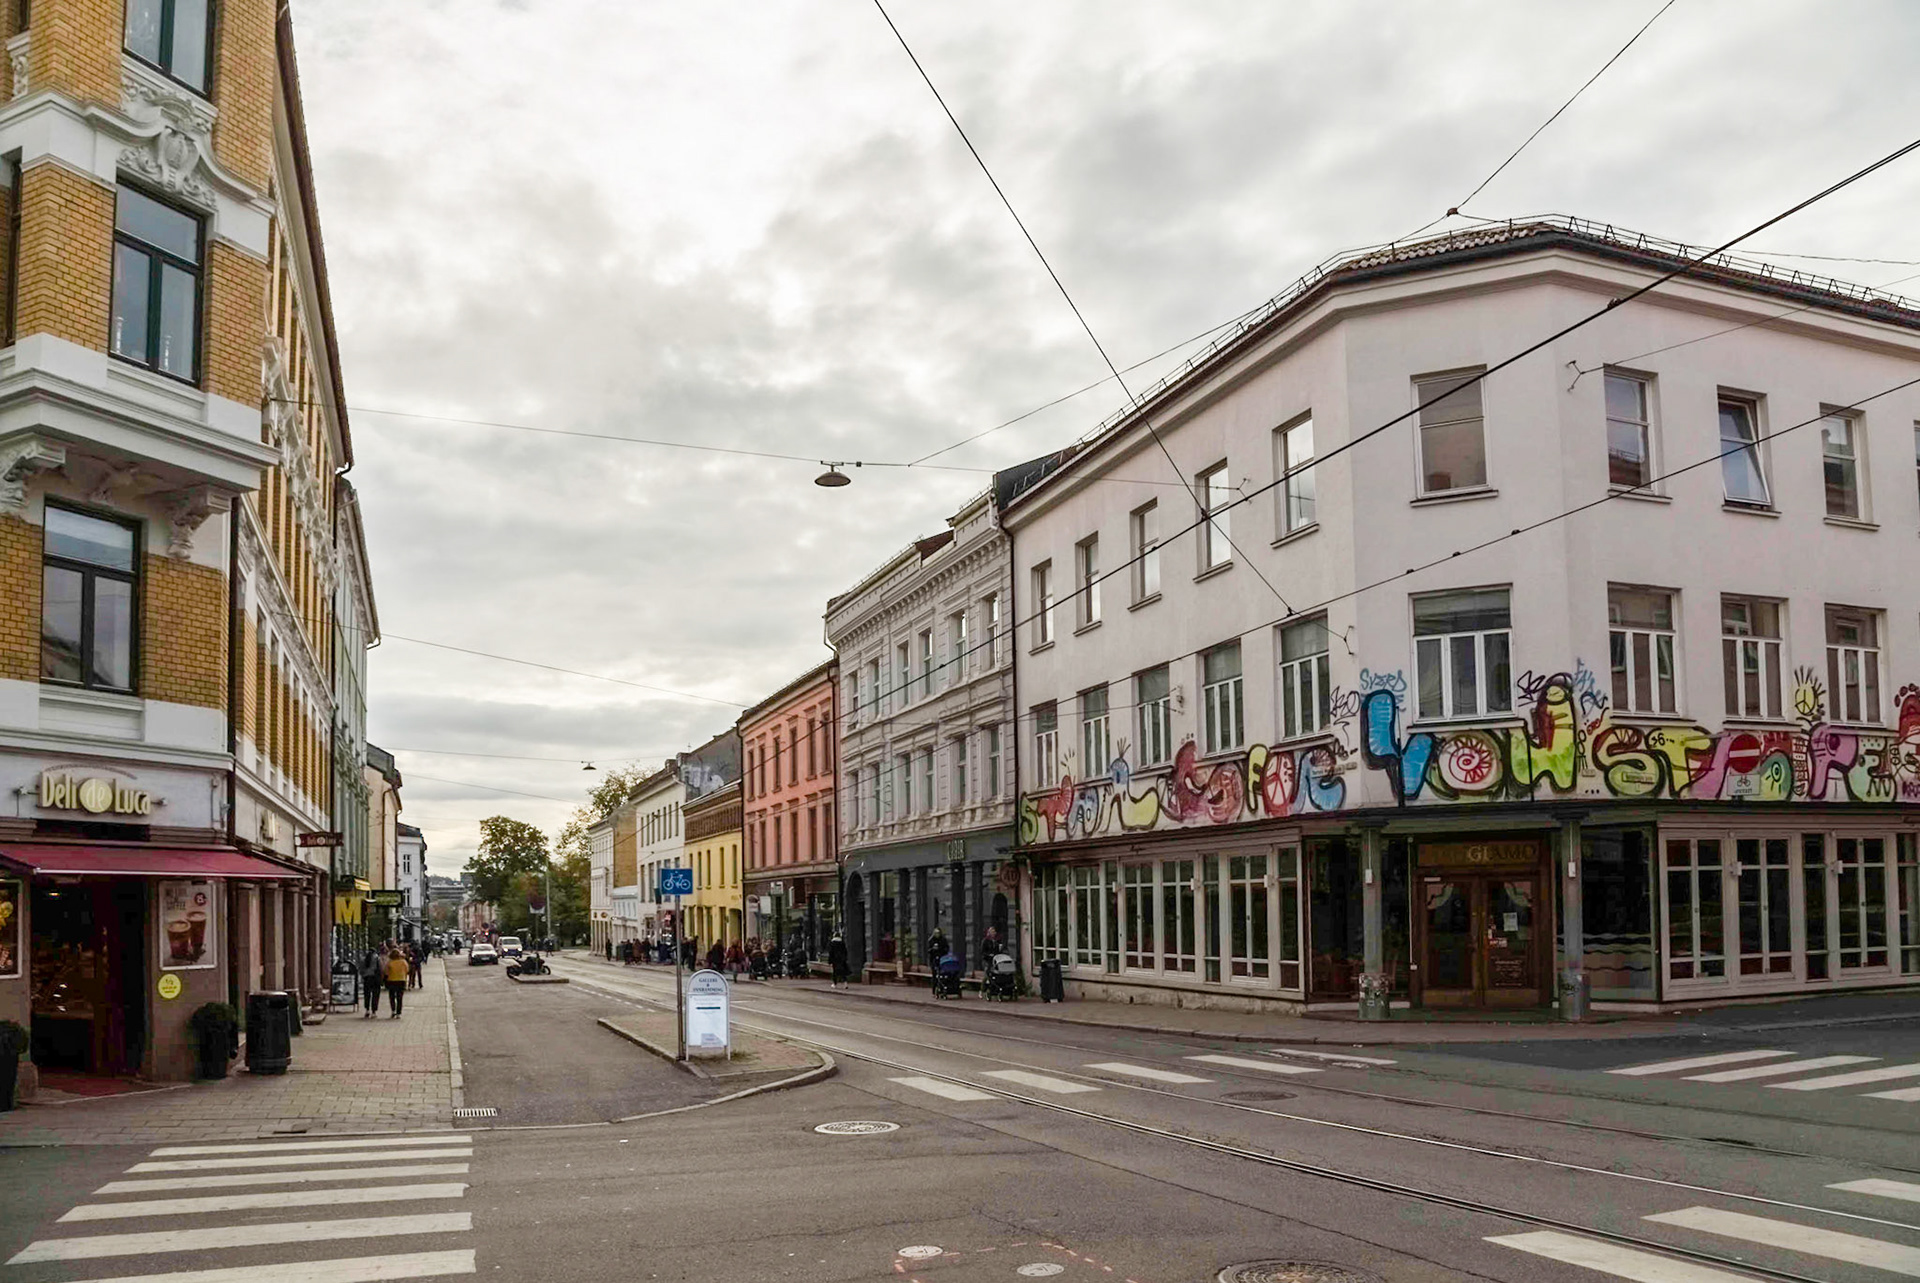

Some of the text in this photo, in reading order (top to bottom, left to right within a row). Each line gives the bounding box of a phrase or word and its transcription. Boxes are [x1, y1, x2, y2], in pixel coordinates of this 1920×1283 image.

[42, 772, 151, 815] Deli de Luca
[335, 896, 361, 925] M
